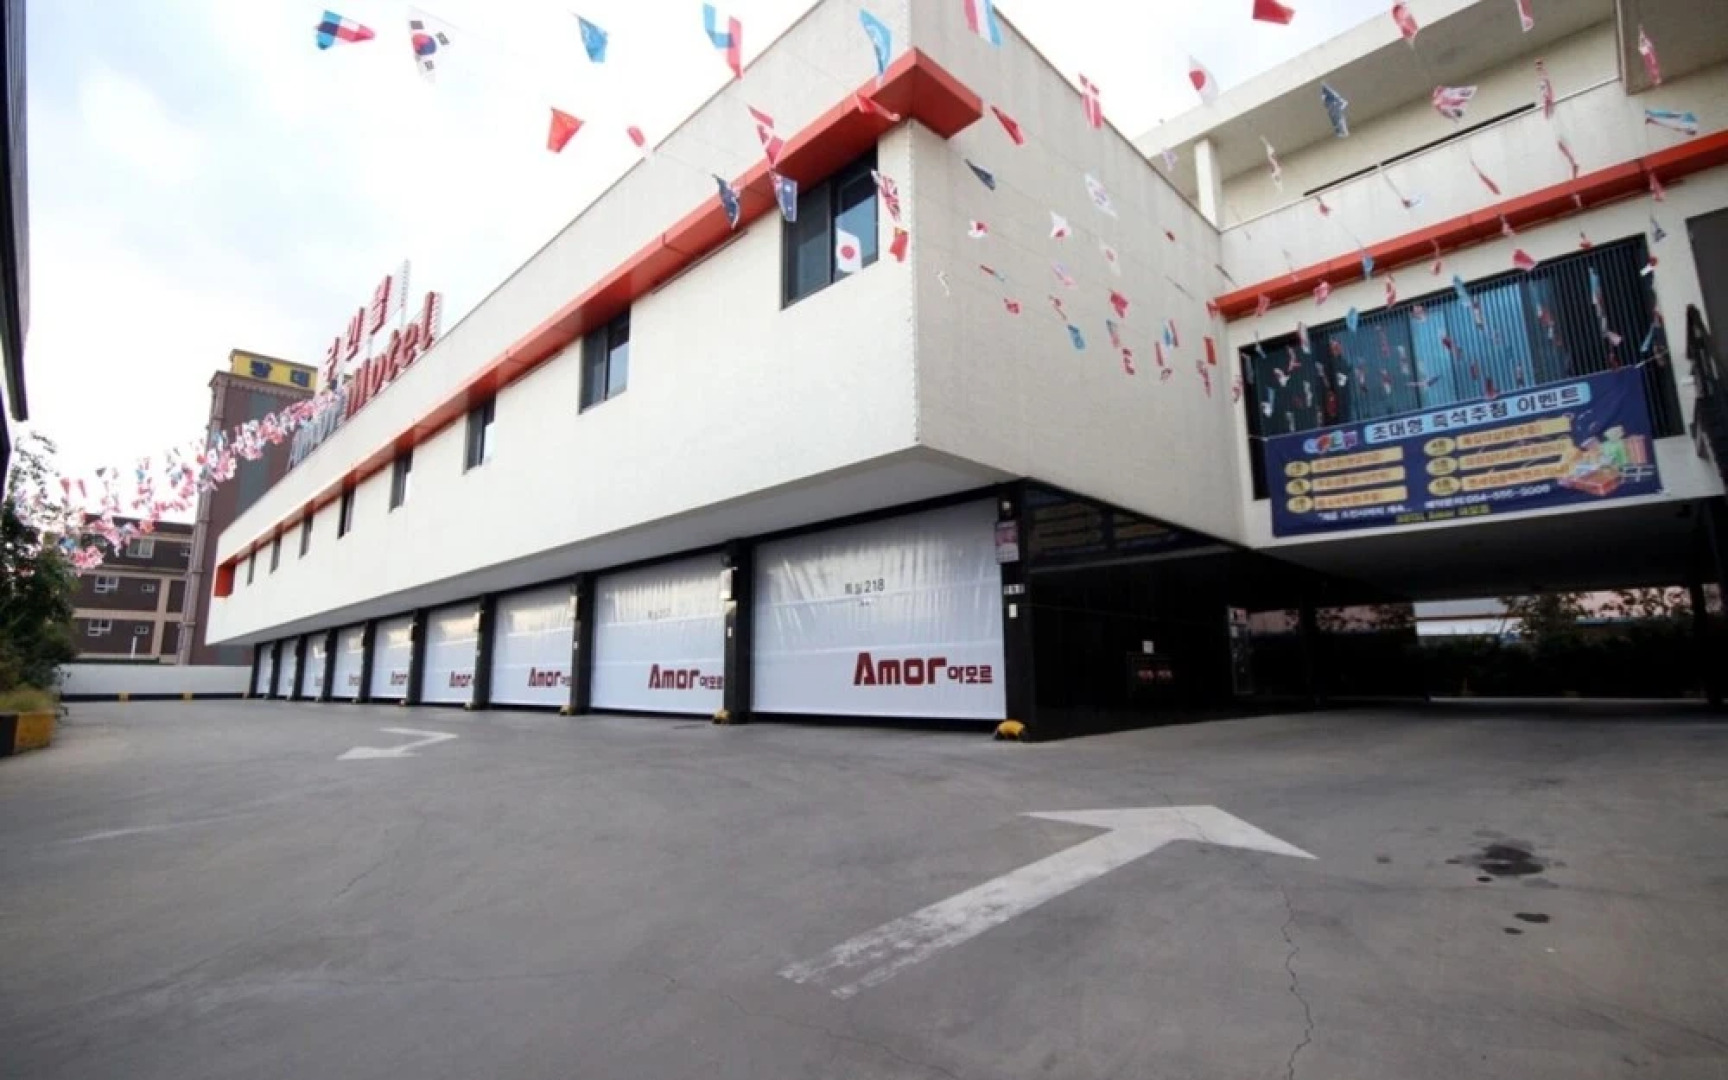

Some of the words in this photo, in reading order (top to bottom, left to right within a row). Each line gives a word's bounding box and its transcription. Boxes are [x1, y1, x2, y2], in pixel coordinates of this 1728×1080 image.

[1372, 418, 1424, 440] 초대형
[1517, 387, 1581, 412] 이벤트
[528, 667, 561, 687] Amor
[648, 663, 700, 689] Amor
[854, 652, 947, 685] Amor
[947, 664, 993, 684] 아모르
